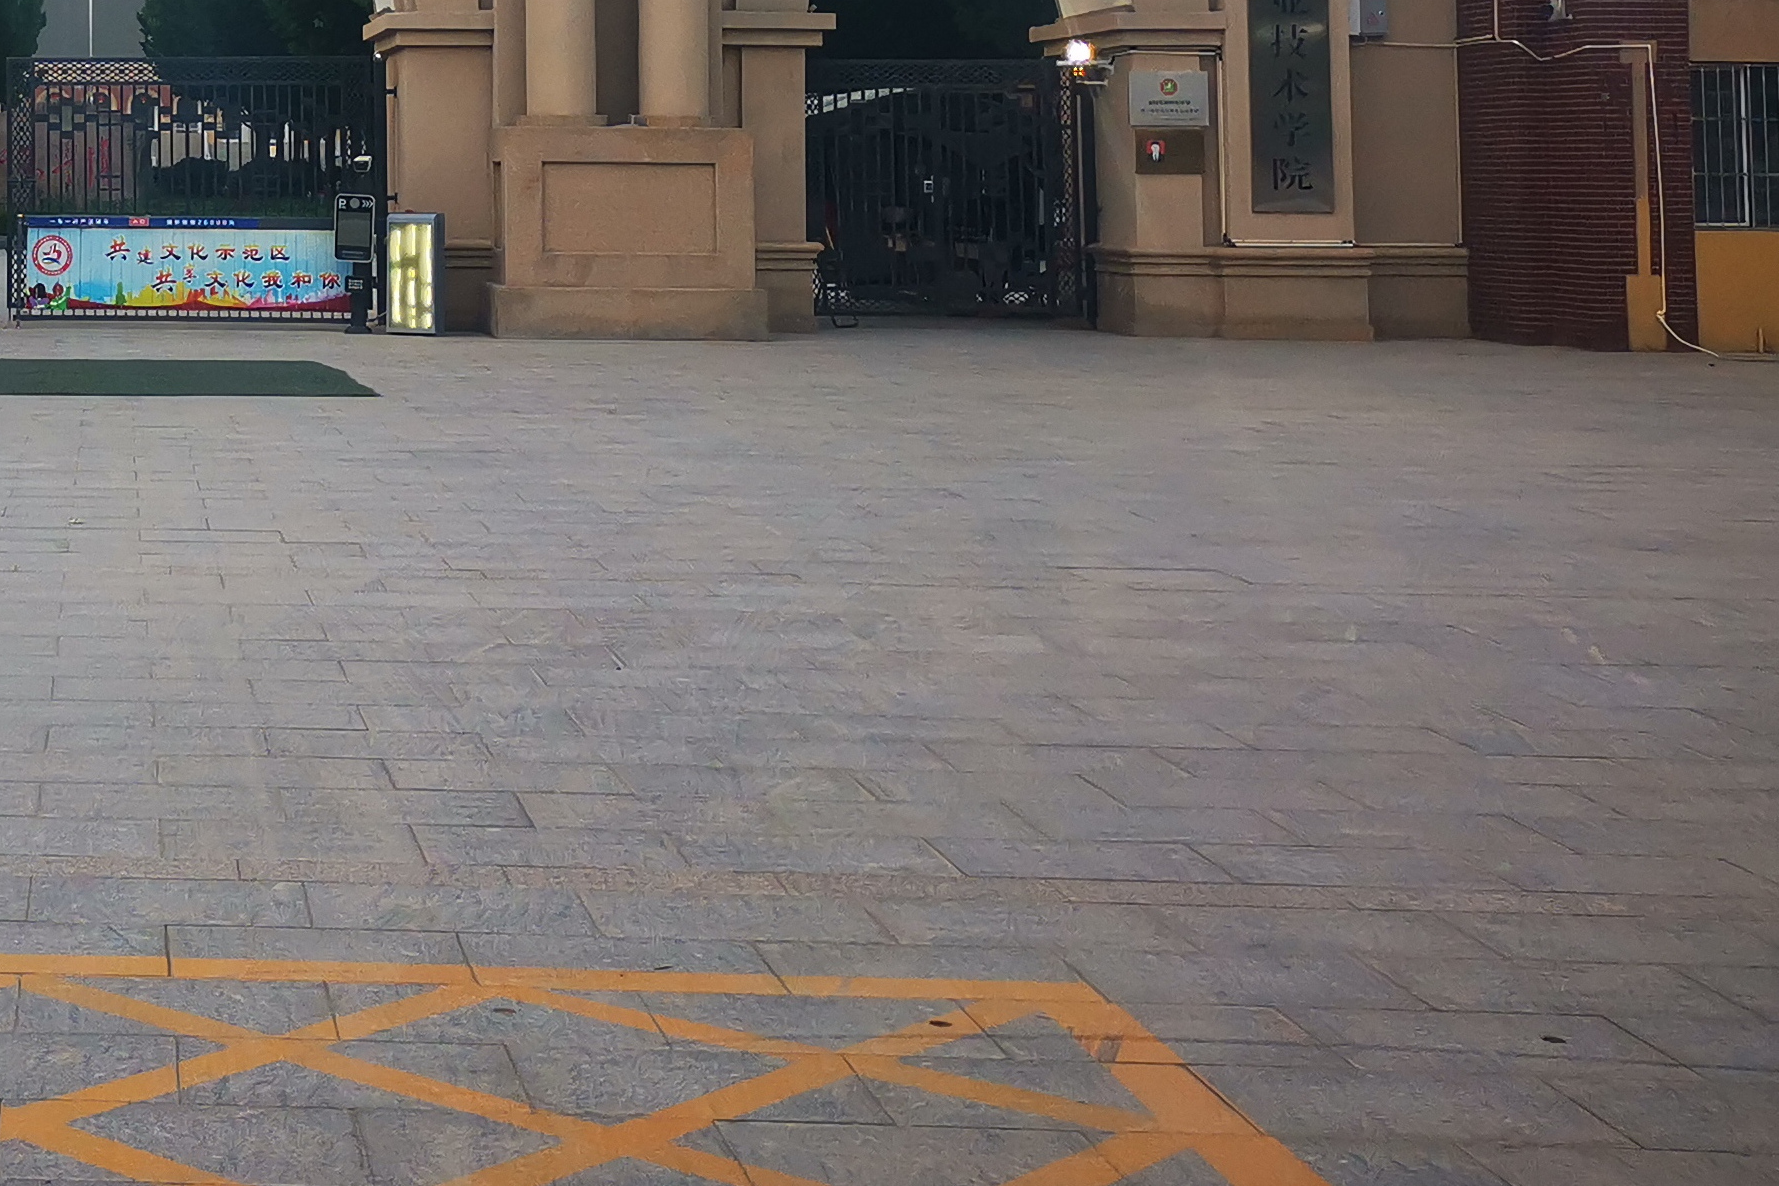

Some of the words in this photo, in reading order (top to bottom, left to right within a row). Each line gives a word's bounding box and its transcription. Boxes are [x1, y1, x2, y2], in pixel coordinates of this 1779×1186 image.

[105, 235, 291, 265] 共建文化示范区
[151, 263, 341, 292] 共享文化我和你
